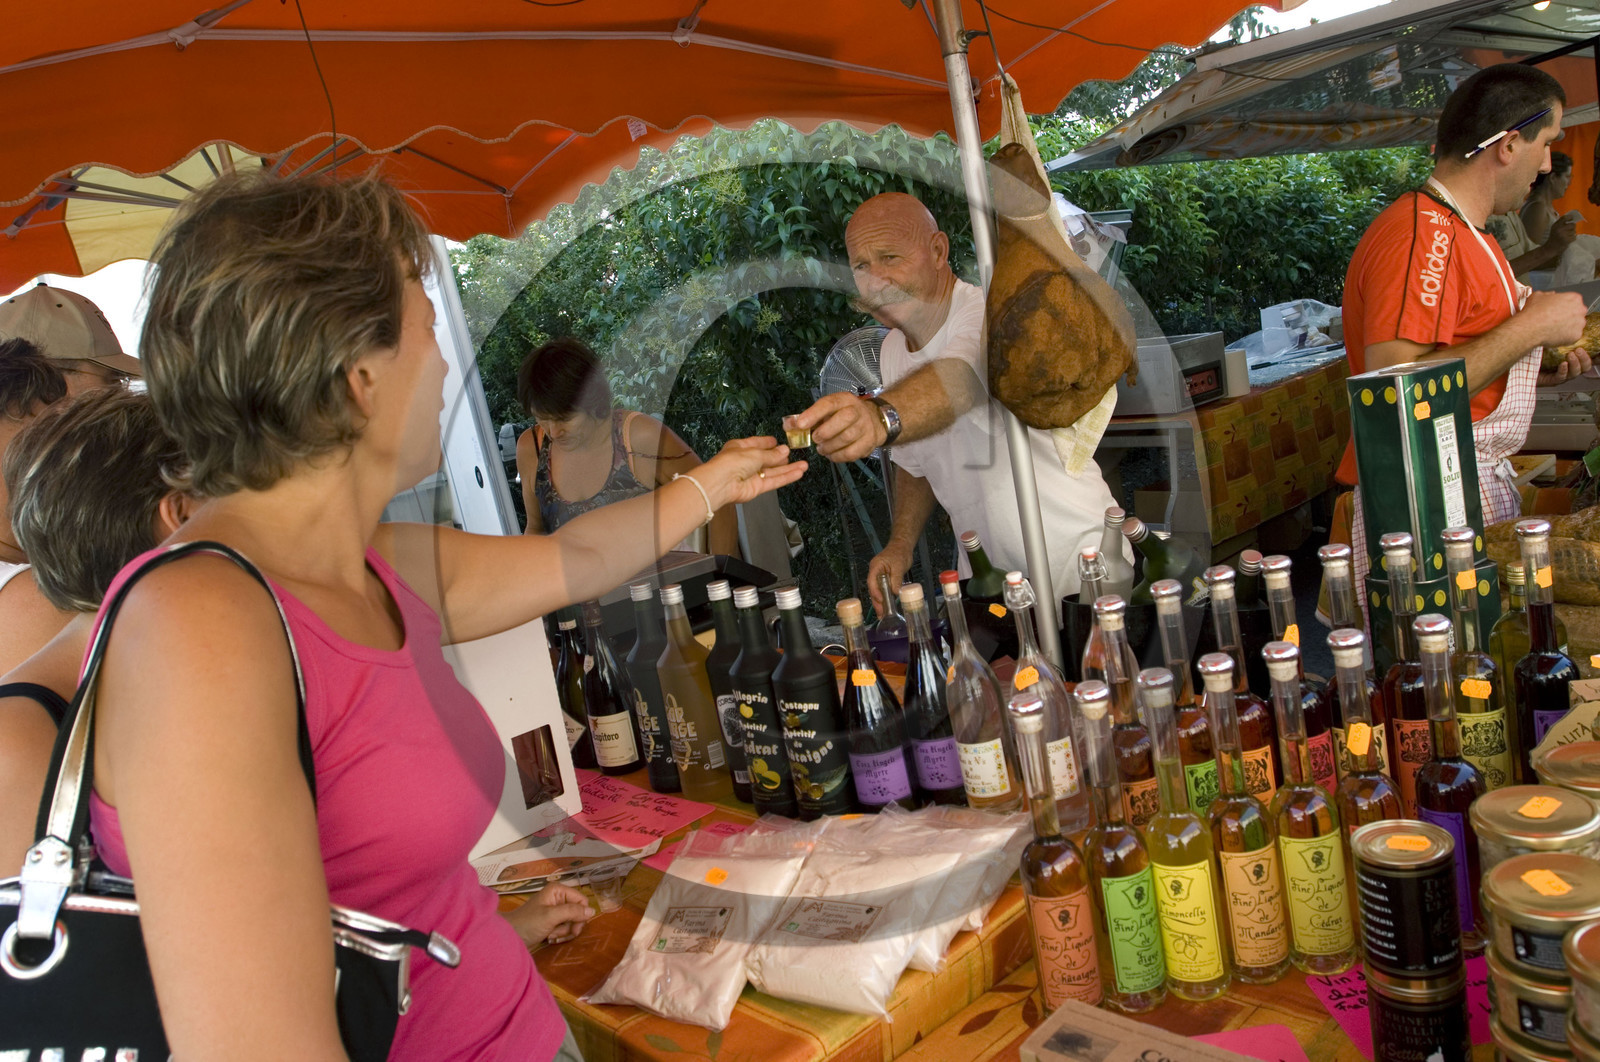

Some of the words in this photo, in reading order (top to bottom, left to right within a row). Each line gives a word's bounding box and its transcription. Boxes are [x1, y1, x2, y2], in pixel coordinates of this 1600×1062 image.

[1420, 230, 1449, 306] adidas
[1291, 877, 1311, 894] Fine
[1232, 892, 1253, 907] Fine
[1315, 896, 1329, 910] de
[1257, 908, 1270, 921] de
[1113, 917, 1137, 933] Fine
[1040, 935, 1061, 952] Fine
[1139, 932, 1151, 946] de
[1064, 954, 1077, 969] de
[1316, 975, 1352, 986] Vin
[1356, 970, 1366, 981] d
